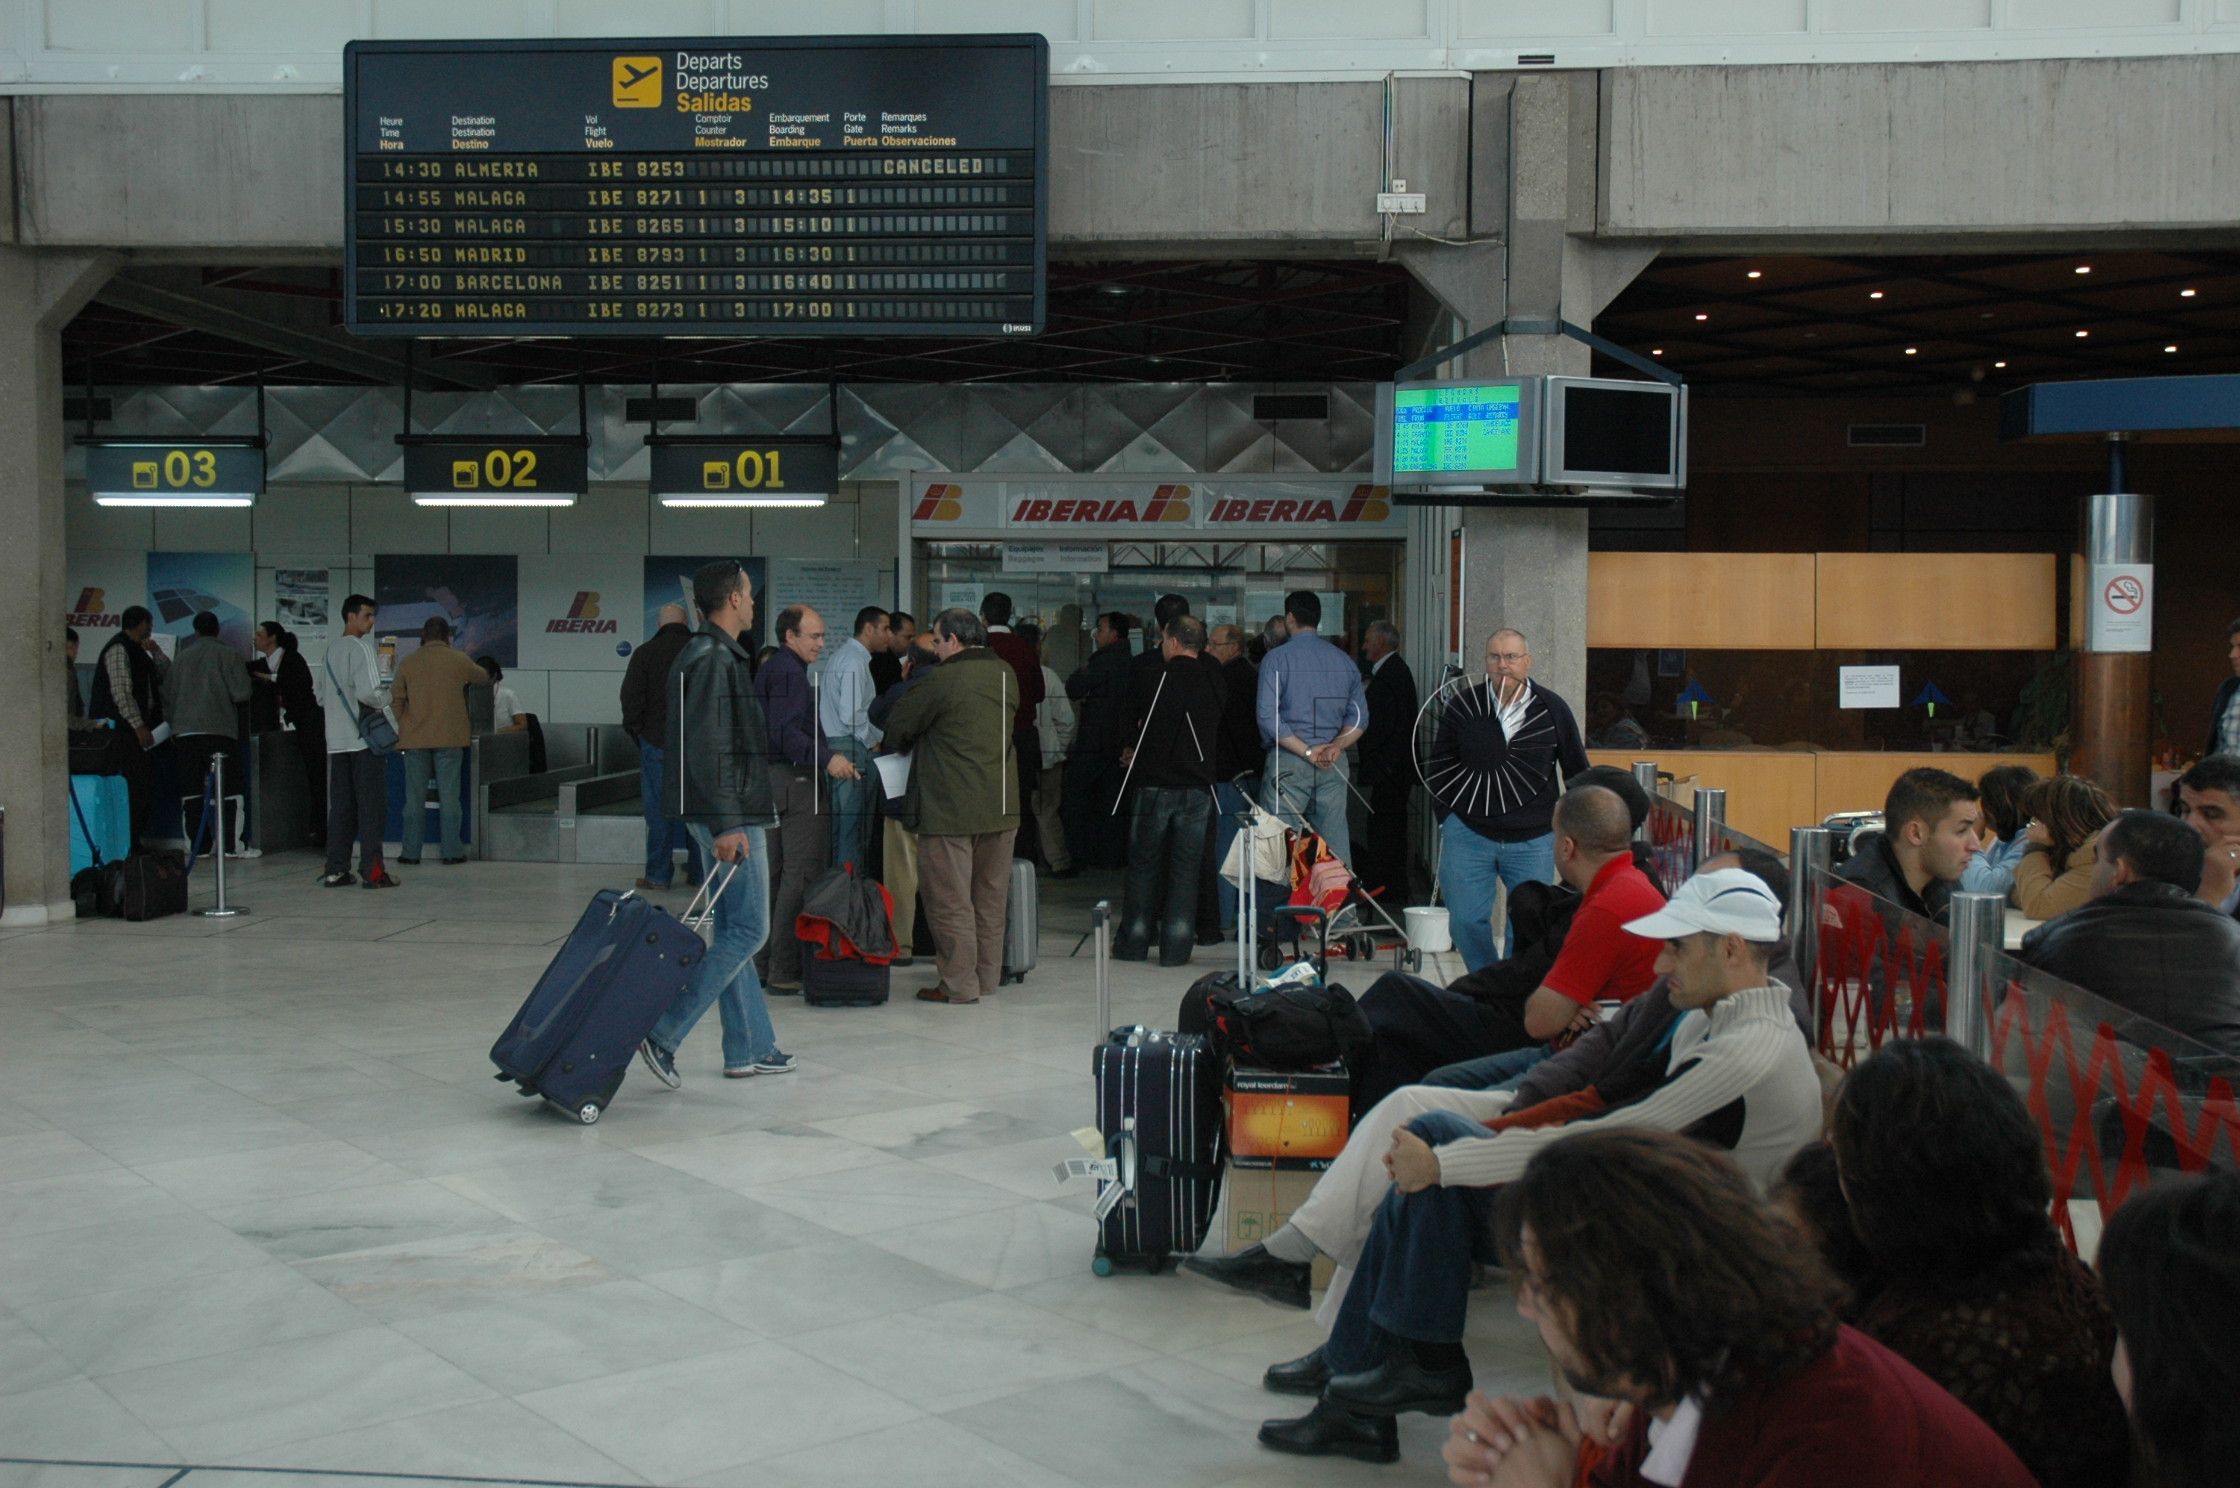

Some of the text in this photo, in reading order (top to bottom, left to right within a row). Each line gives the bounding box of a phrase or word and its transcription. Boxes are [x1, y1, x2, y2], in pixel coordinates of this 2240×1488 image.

[677, 52, 742, 73] Departs
[677, 72, 768, 93] Departures
[677, 92, 752, 112] Salidas
[380, 112, 927, 126] Heure Destination Vol Comptoir Embarquement Porte Remarques
[381, 124, 917, 137] Time Destination Flight Counter Boarding Gate Remarks
[380, 136, 956, 150] Hora Destino Vuelo Mostrador Embarque Puerta Observaciones
[384, 159, 982, 177] 14:30 ALMERIA IBE 8253 CANCELED
[384, 189, 855, 205] 14:55 MALAGA IBE 8271 1 3 14:35 1
[384, 218, 855, 233] 15:30 MALAGA IBE 8265 1 3 15:10 1
[384, 246, 855, 262] 16:50 MADRID IBE 8793 1 3 16:30 1
[384, 274, 855, 290] 17:00 BARCELONA IBE 8251 1 3 16:40 1
[385, 302, 855, 317] 17:20 MALAGA IBE 8273 1 3 17:00 1
[165, 450, 216, 488] 03
[485, 450, 537, 488] 02
[736, 450, 784, 488] 01
[1012, 500, 1138, 522] IBERIA
[1208, 500, 1336, 522] IBERIA
[66, 614, 120, 627] BERIA
[546, 620, 617, 633] IBERIA
